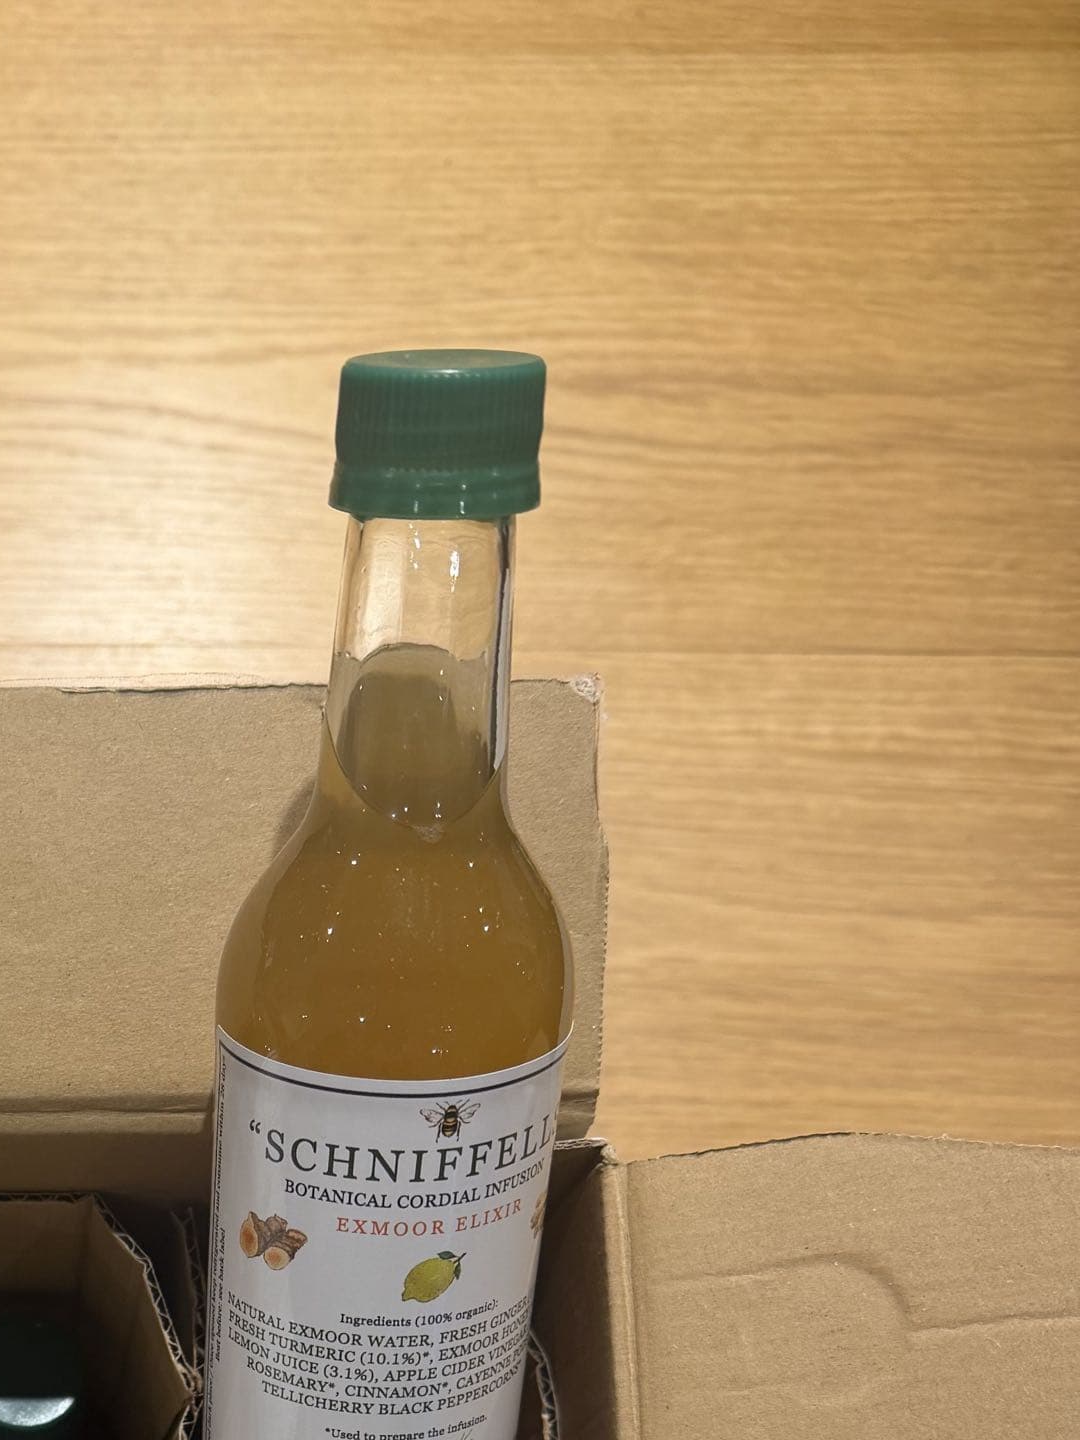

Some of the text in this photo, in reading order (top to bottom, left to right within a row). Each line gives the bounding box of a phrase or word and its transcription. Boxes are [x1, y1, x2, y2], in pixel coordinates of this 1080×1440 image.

[249, 1114, 555, 1183] “SCHNIFFELL
[285, 1158, 545, 1209] BOTANICAL CORDIAL INFUSION
[336, 1198, 521, 1237] EXMOOR ELIXIR
[228, 1291, 285, 1331] NATURAL
[288, 1321, 363, 1346] EXMOOR
[368, 1334, 434, 1348] WATER,
[439, 1320, 488, 1344] FRESH
[340, 1299, 499, 1327] Ingredients (100% organic):
[228, 1326, 269, 1359] LEMON
[272, 1351, 319, 1374] JUICE
[323, 1364, 378, 1383] (3.1%),
[383, 1367, 437, 1382] APPLE
[441, 1354, 486, 1377] CIDER
[229, 1310, 266, 1341] FRESH
[268, 1332, 356, 1362] TURMERIC
[438, 1334, 499, 1361] EXMOOR
[456, 1355, 512, 1389] CAYENNE
[261, 1380, 374, 1414] TELLICHERRY
[379, 1400, 434, 1415] BLACK
[364, 1432, 376, 1440] to
[428, 1426, 445, 1437] the
[447, 1413, 487, 1434] infusion.
